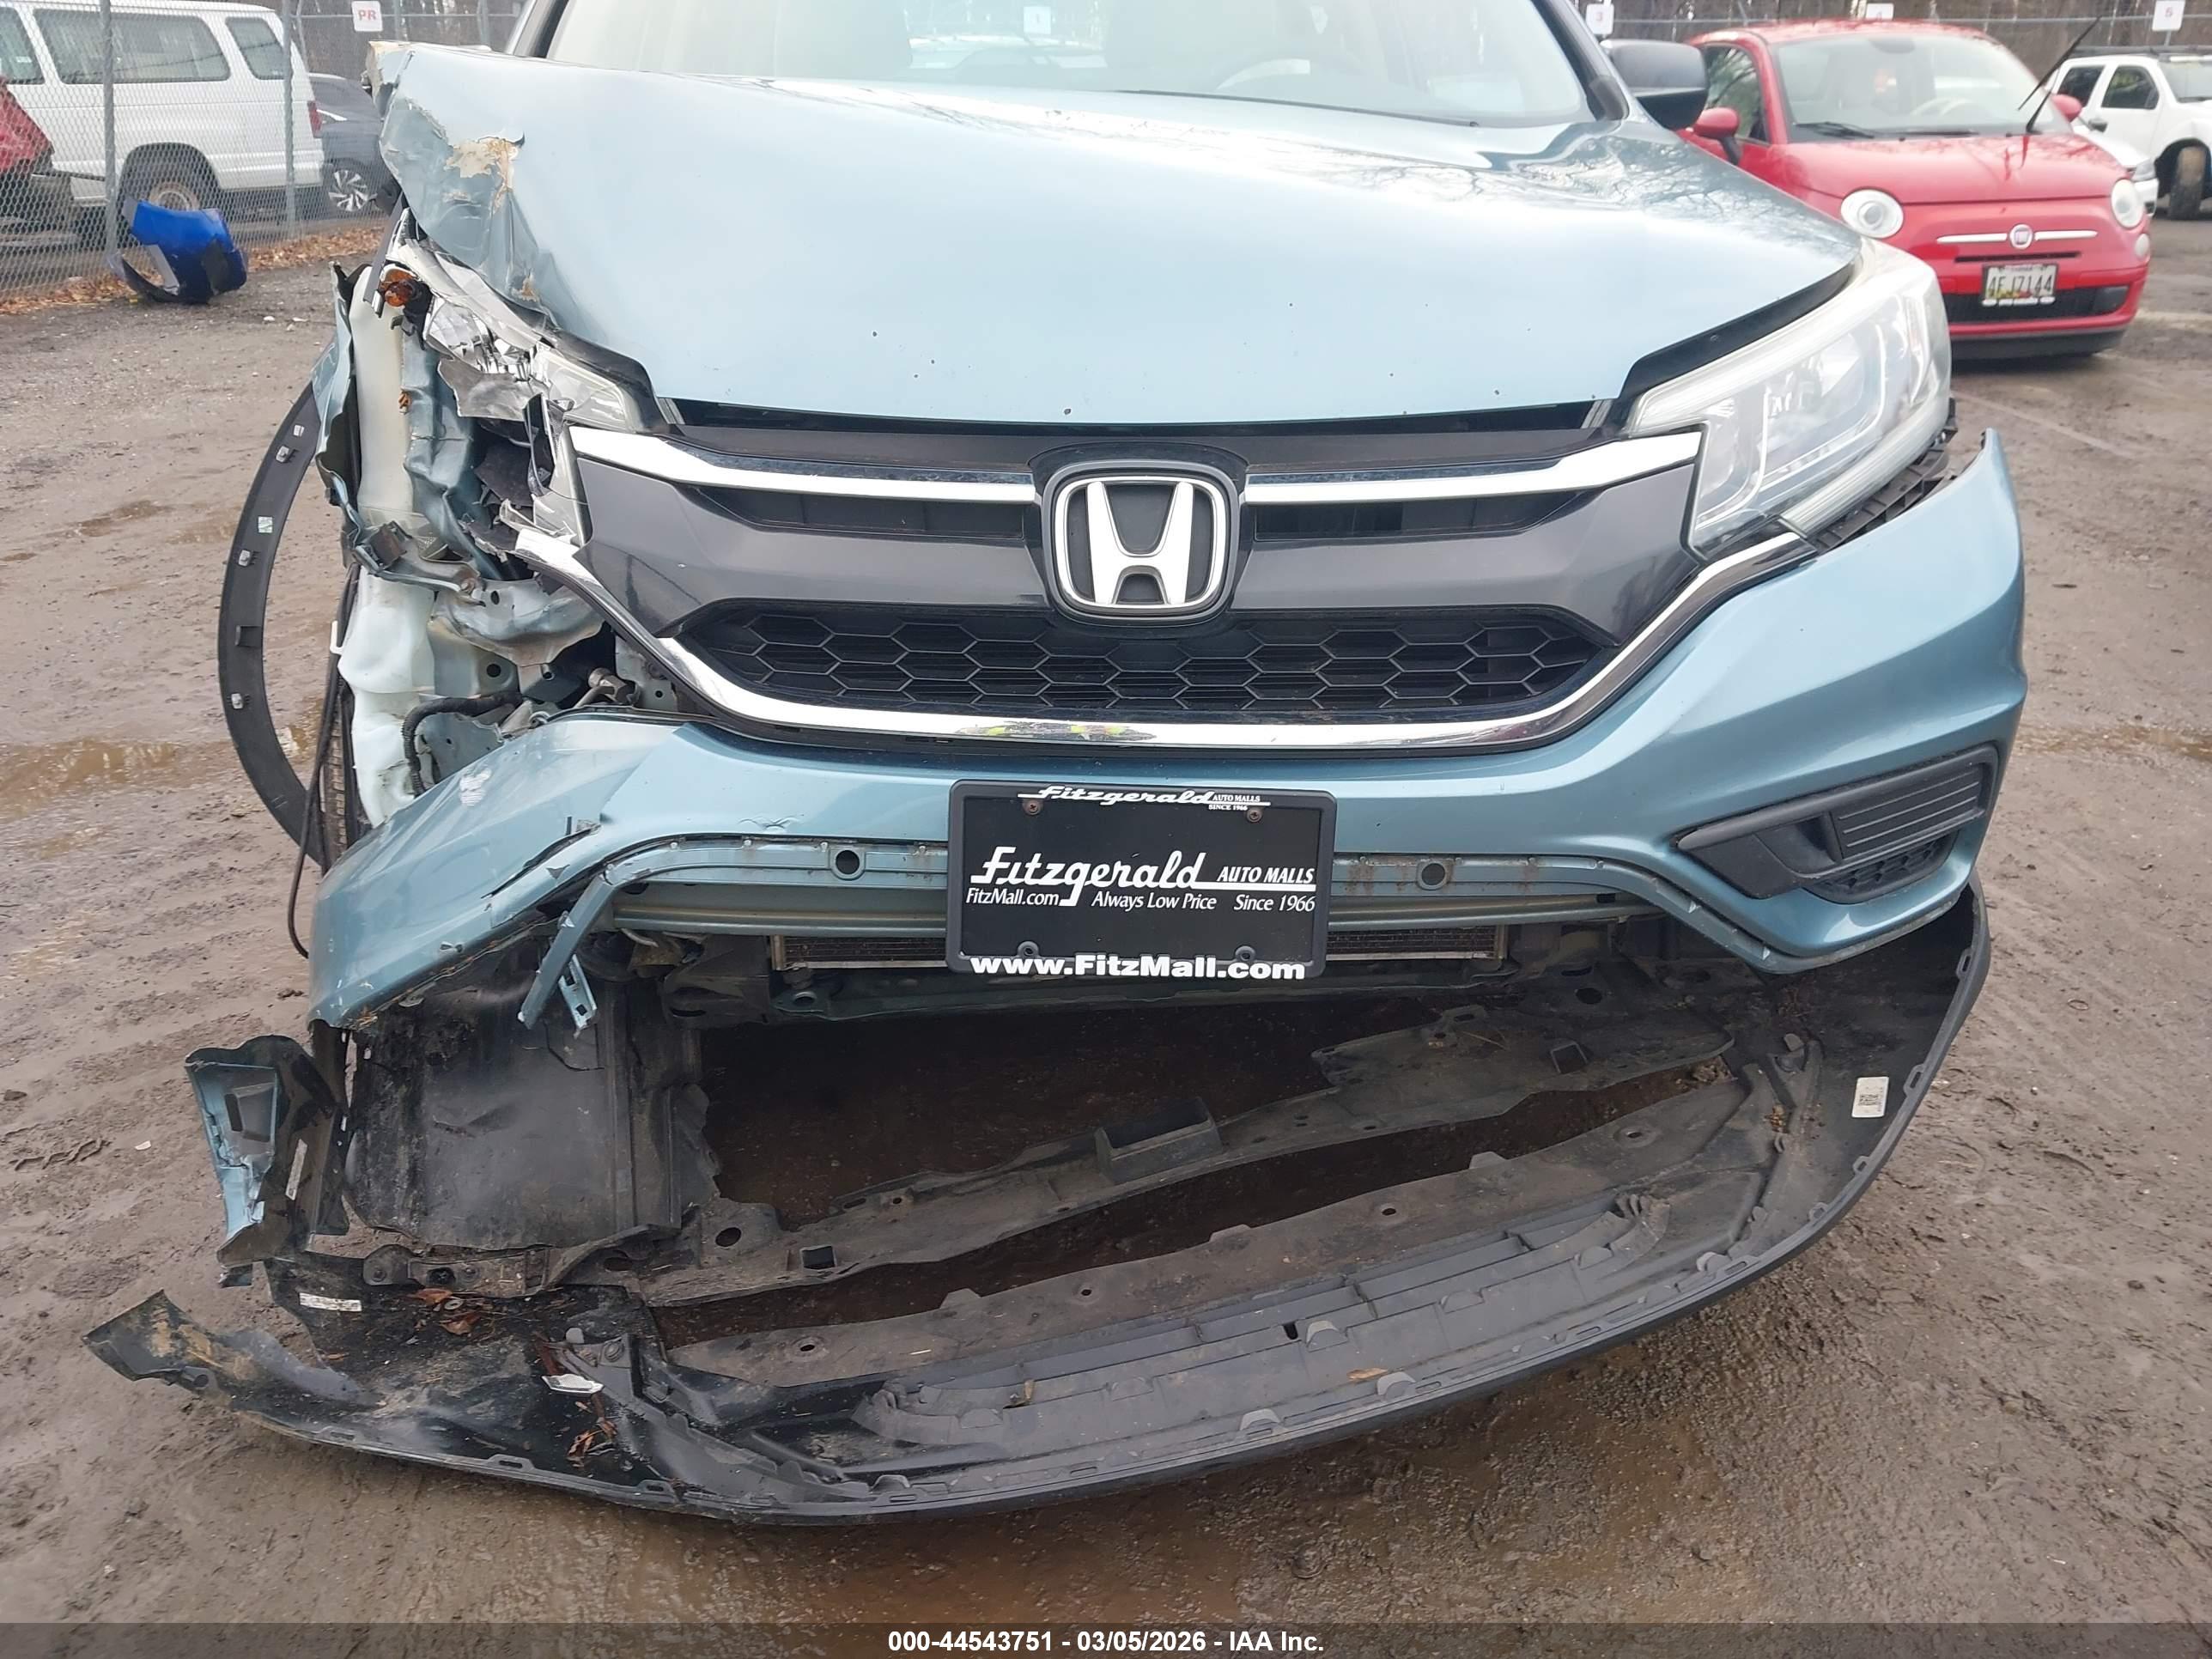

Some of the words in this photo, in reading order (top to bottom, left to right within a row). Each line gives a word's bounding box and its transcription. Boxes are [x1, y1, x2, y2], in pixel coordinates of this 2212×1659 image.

[357, 9, 376, 21] PR
[1018, 786, 1215, 805] Fitzgerald
[969, 846, 1207, 907] Fitzgerald
[1216, 866, 1261, 884] AUTO
[1264, 867, 1316, 884] MALLS
[965, 887, 1060, 906] FitzMall.com
[1091, 890, 1145, 912] Always
[1147, 892, 1180, 910] Low
[1181, 893, 1218, 910] Price
[1234, 894, 1274, 912] Since
[1279, 895, 1316, 913] 1966
[969, 954, 1306, 981] www.FitzMall.com
